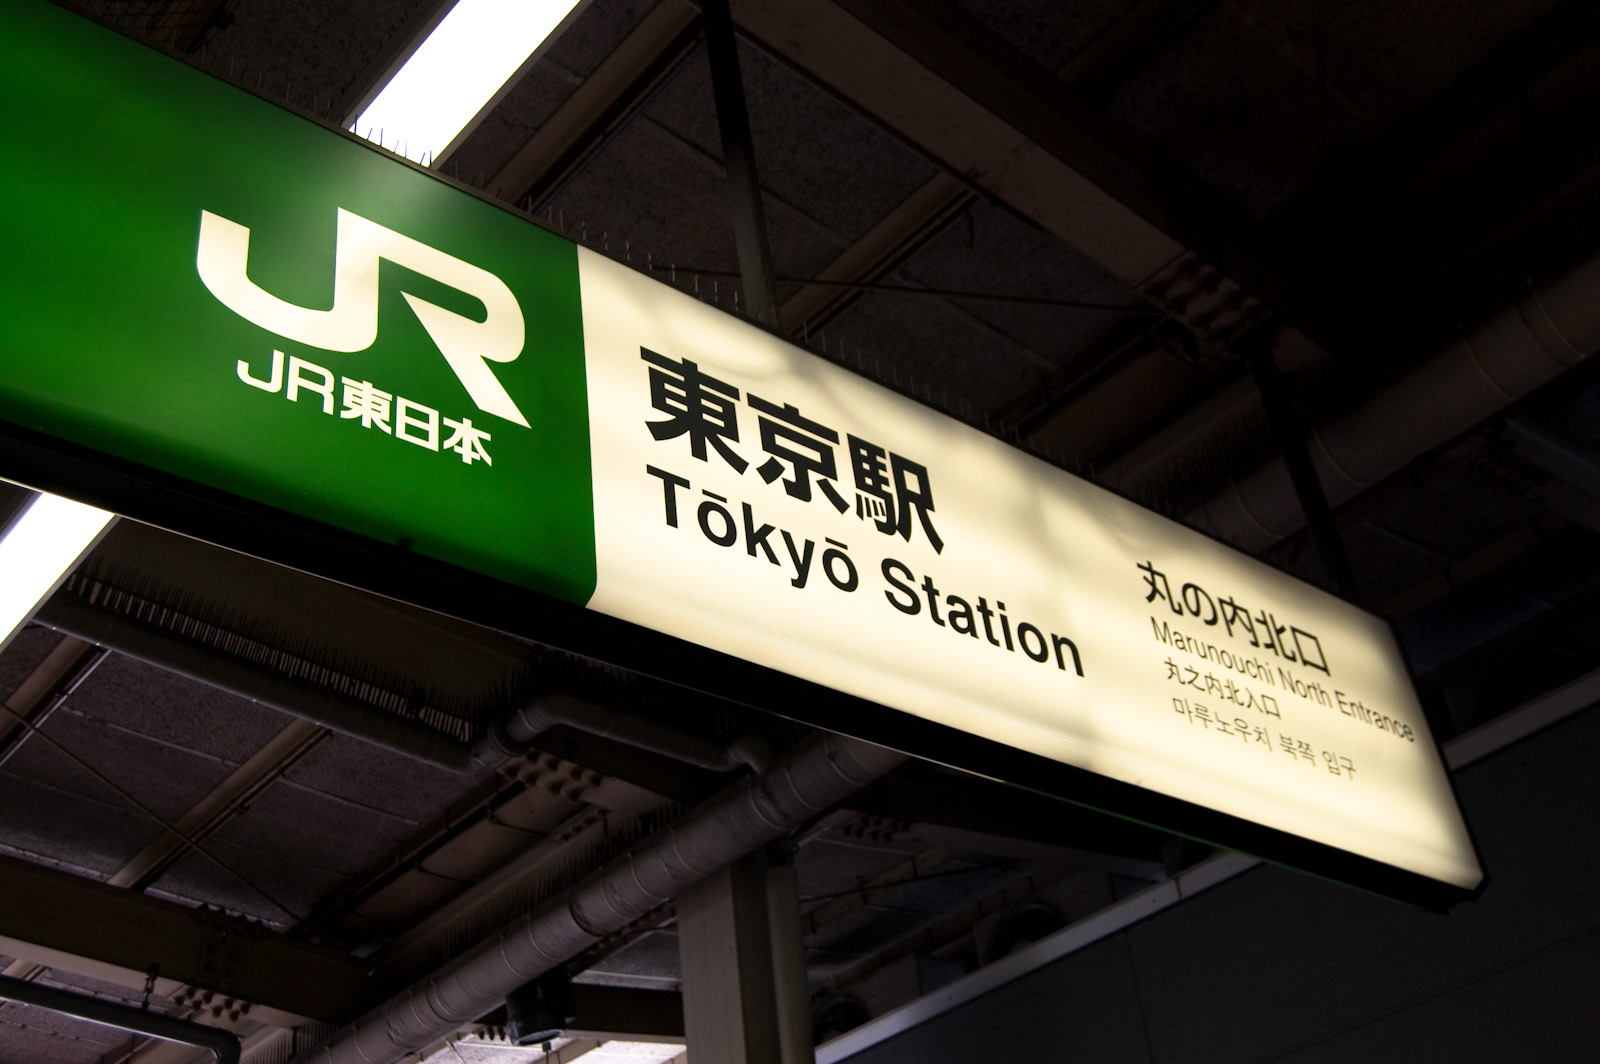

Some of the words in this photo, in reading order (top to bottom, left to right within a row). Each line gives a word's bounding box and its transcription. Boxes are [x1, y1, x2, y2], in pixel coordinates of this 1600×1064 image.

[196, 206, 532, 430] JR
[236, 348, 493, 467] JR東日本
[639, 345, 945, 556] 東京駅
[646, 463, 859, 593] Tōkyō
[880, 557, 1085, 678] Station
[1136, 560, 1332, 677] 丸の内北口
[1150, 616, 1276, 686] Marunouchi
[1277, 666, 1333, 709] North
[1334, 689, 1416, 743] Entrance
[1164, 656, 1282, 720] 丸之内北入口
[1172, 697, 1272, 752] 마루노우치
[1279, 732, 1316, 768] 북쪽
[1322, 750, 1357, 780] 입구
